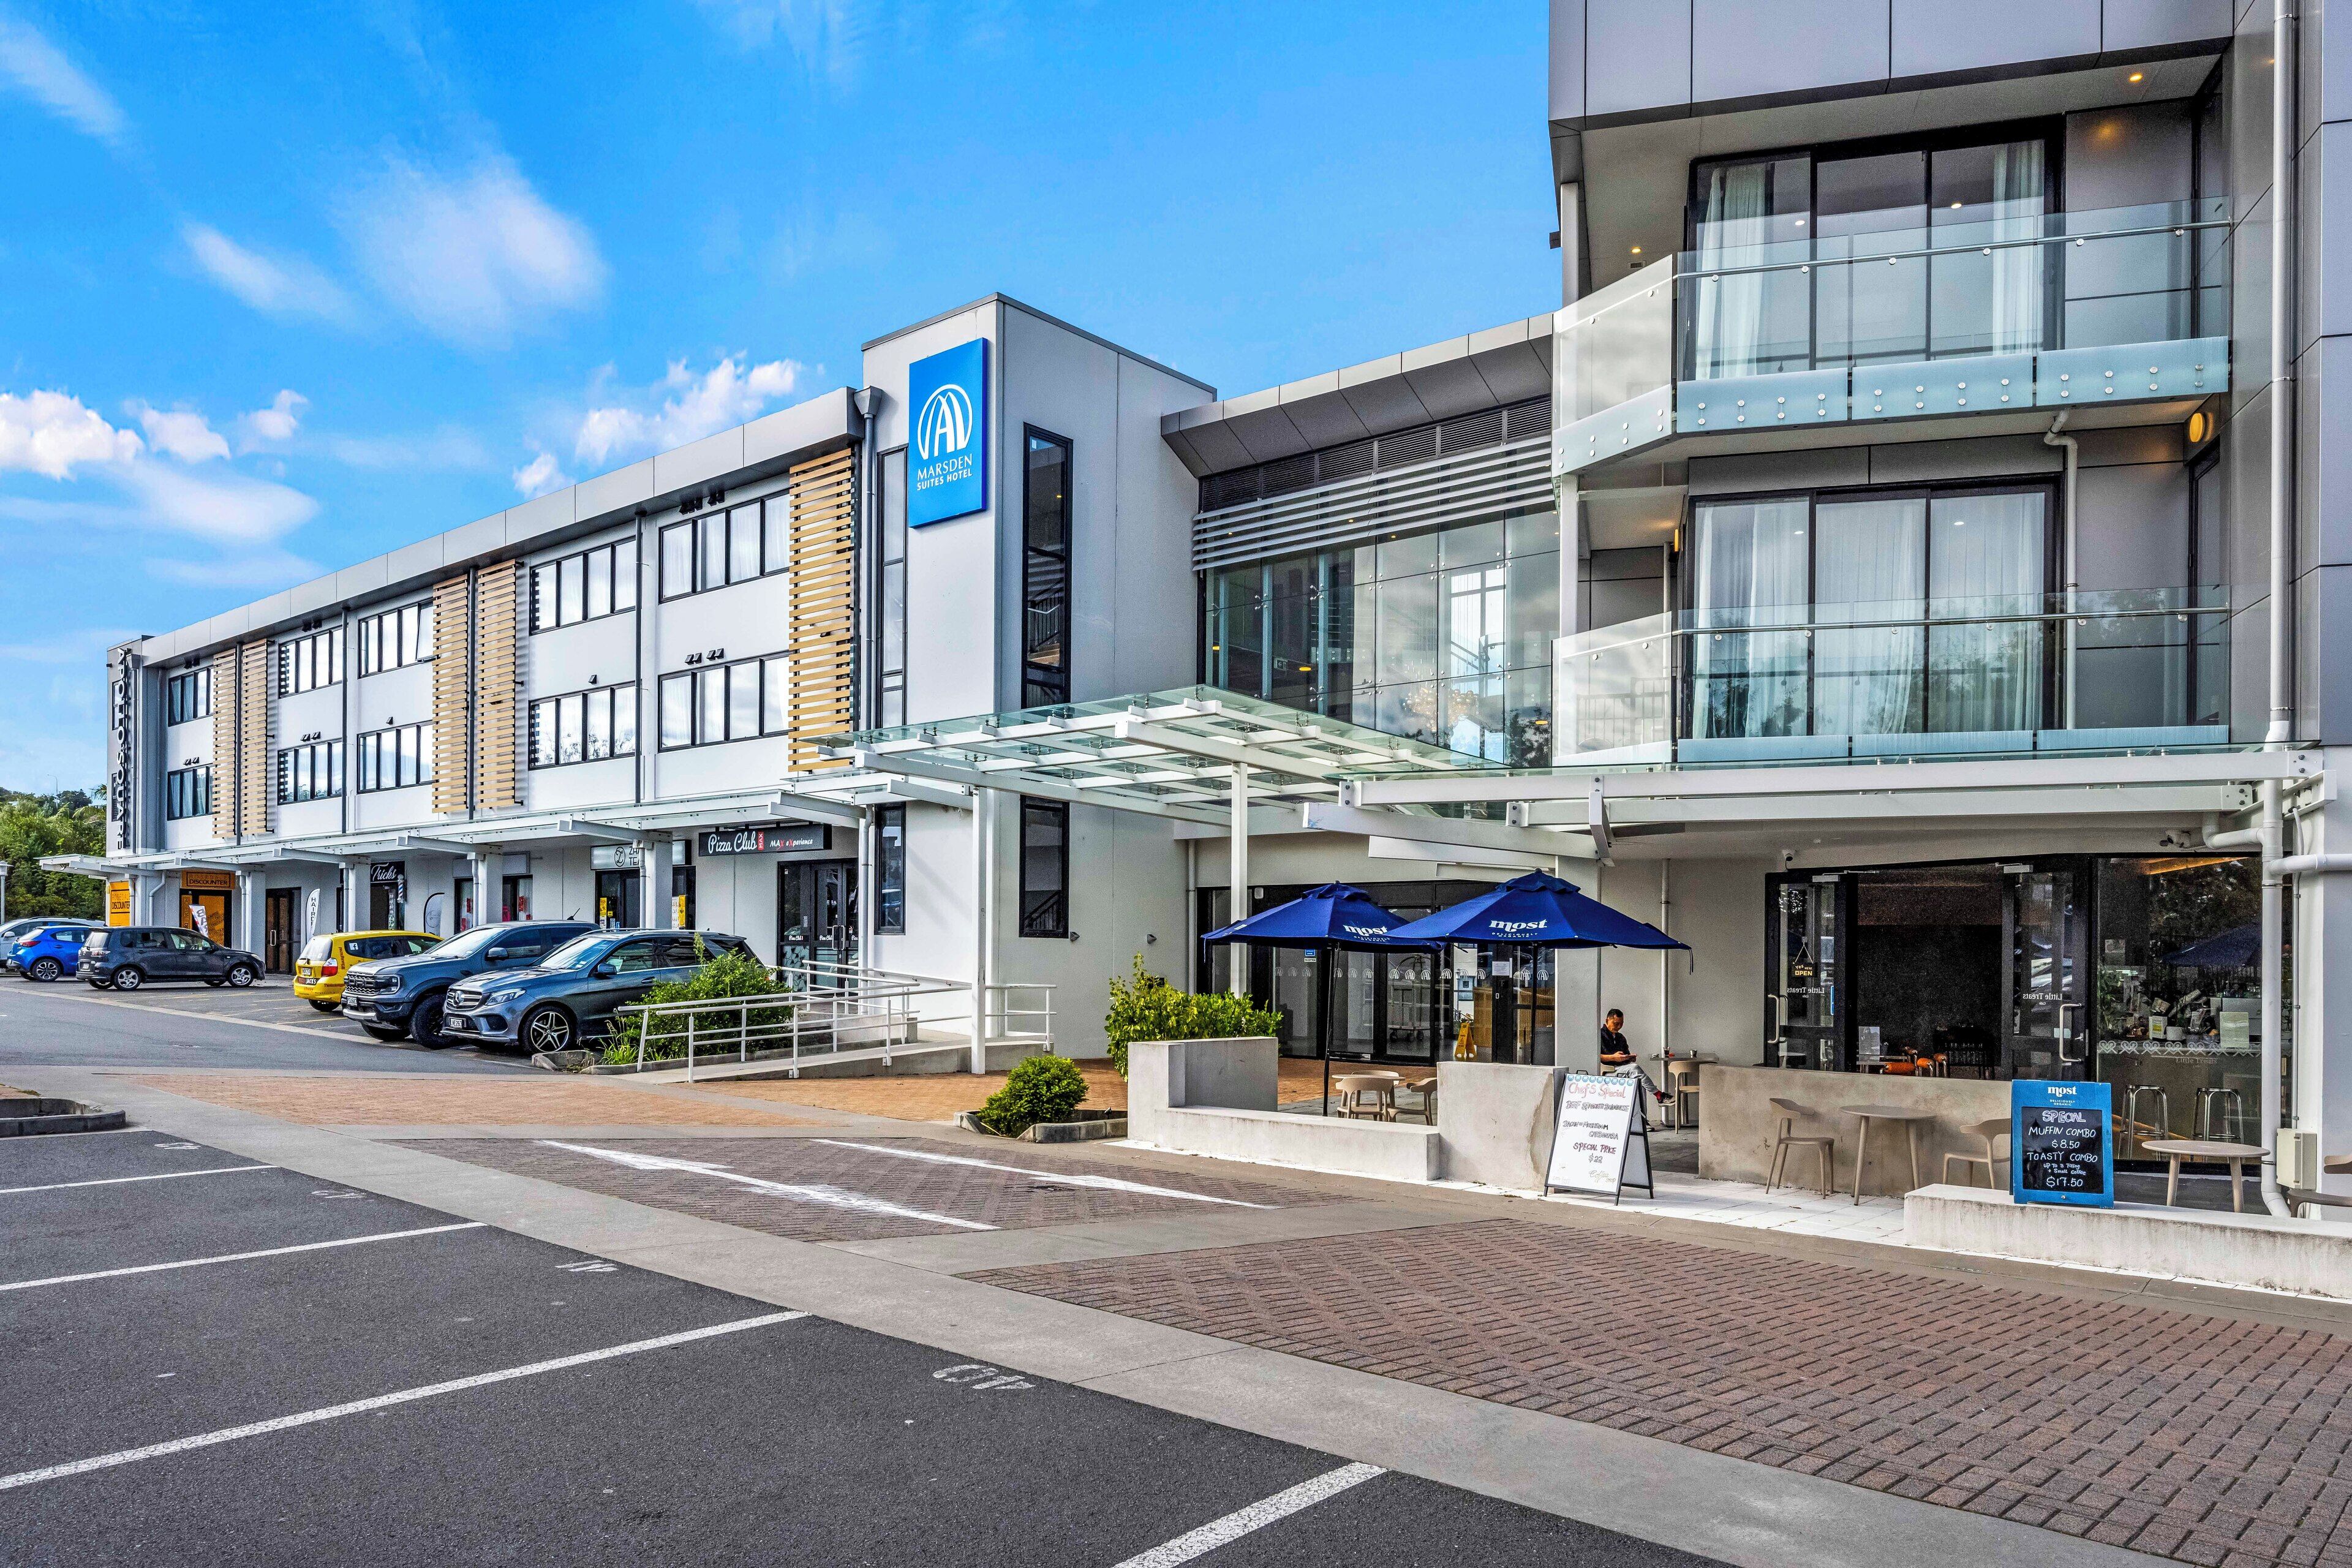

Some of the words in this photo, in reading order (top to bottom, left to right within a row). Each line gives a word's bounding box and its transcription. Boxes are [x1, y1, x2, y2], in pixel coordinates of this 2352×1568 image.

[917, 453, 973, 481] MARSDEN
[917, 476, 944, 491] SUITES
[946, 468, 973, 483] HOTEL
[708, 834, 732, 854] Pizza
[734, 831, 757, 852] Club
[371, 862, 397, 881] Tricks
[1343, 925, 1388, 937] most
[1489, 919, 1548, 932] most
[2048, 1086, 2077, 1097] most
[2042, 1110, 2086, 1123] SPECIAL
[2028, 1126, 2064, 1136] MUFFIN
[2066, 1128, 2096, 1137] COMBO
[1573, 1142, 1597, 1152] SPECIAL
[1600, 1144, 1617, 1155] PRICE
[2070, 1153, 2098, 1163] COMBO
[2046, 1175, 2083, 1188] $17.50
